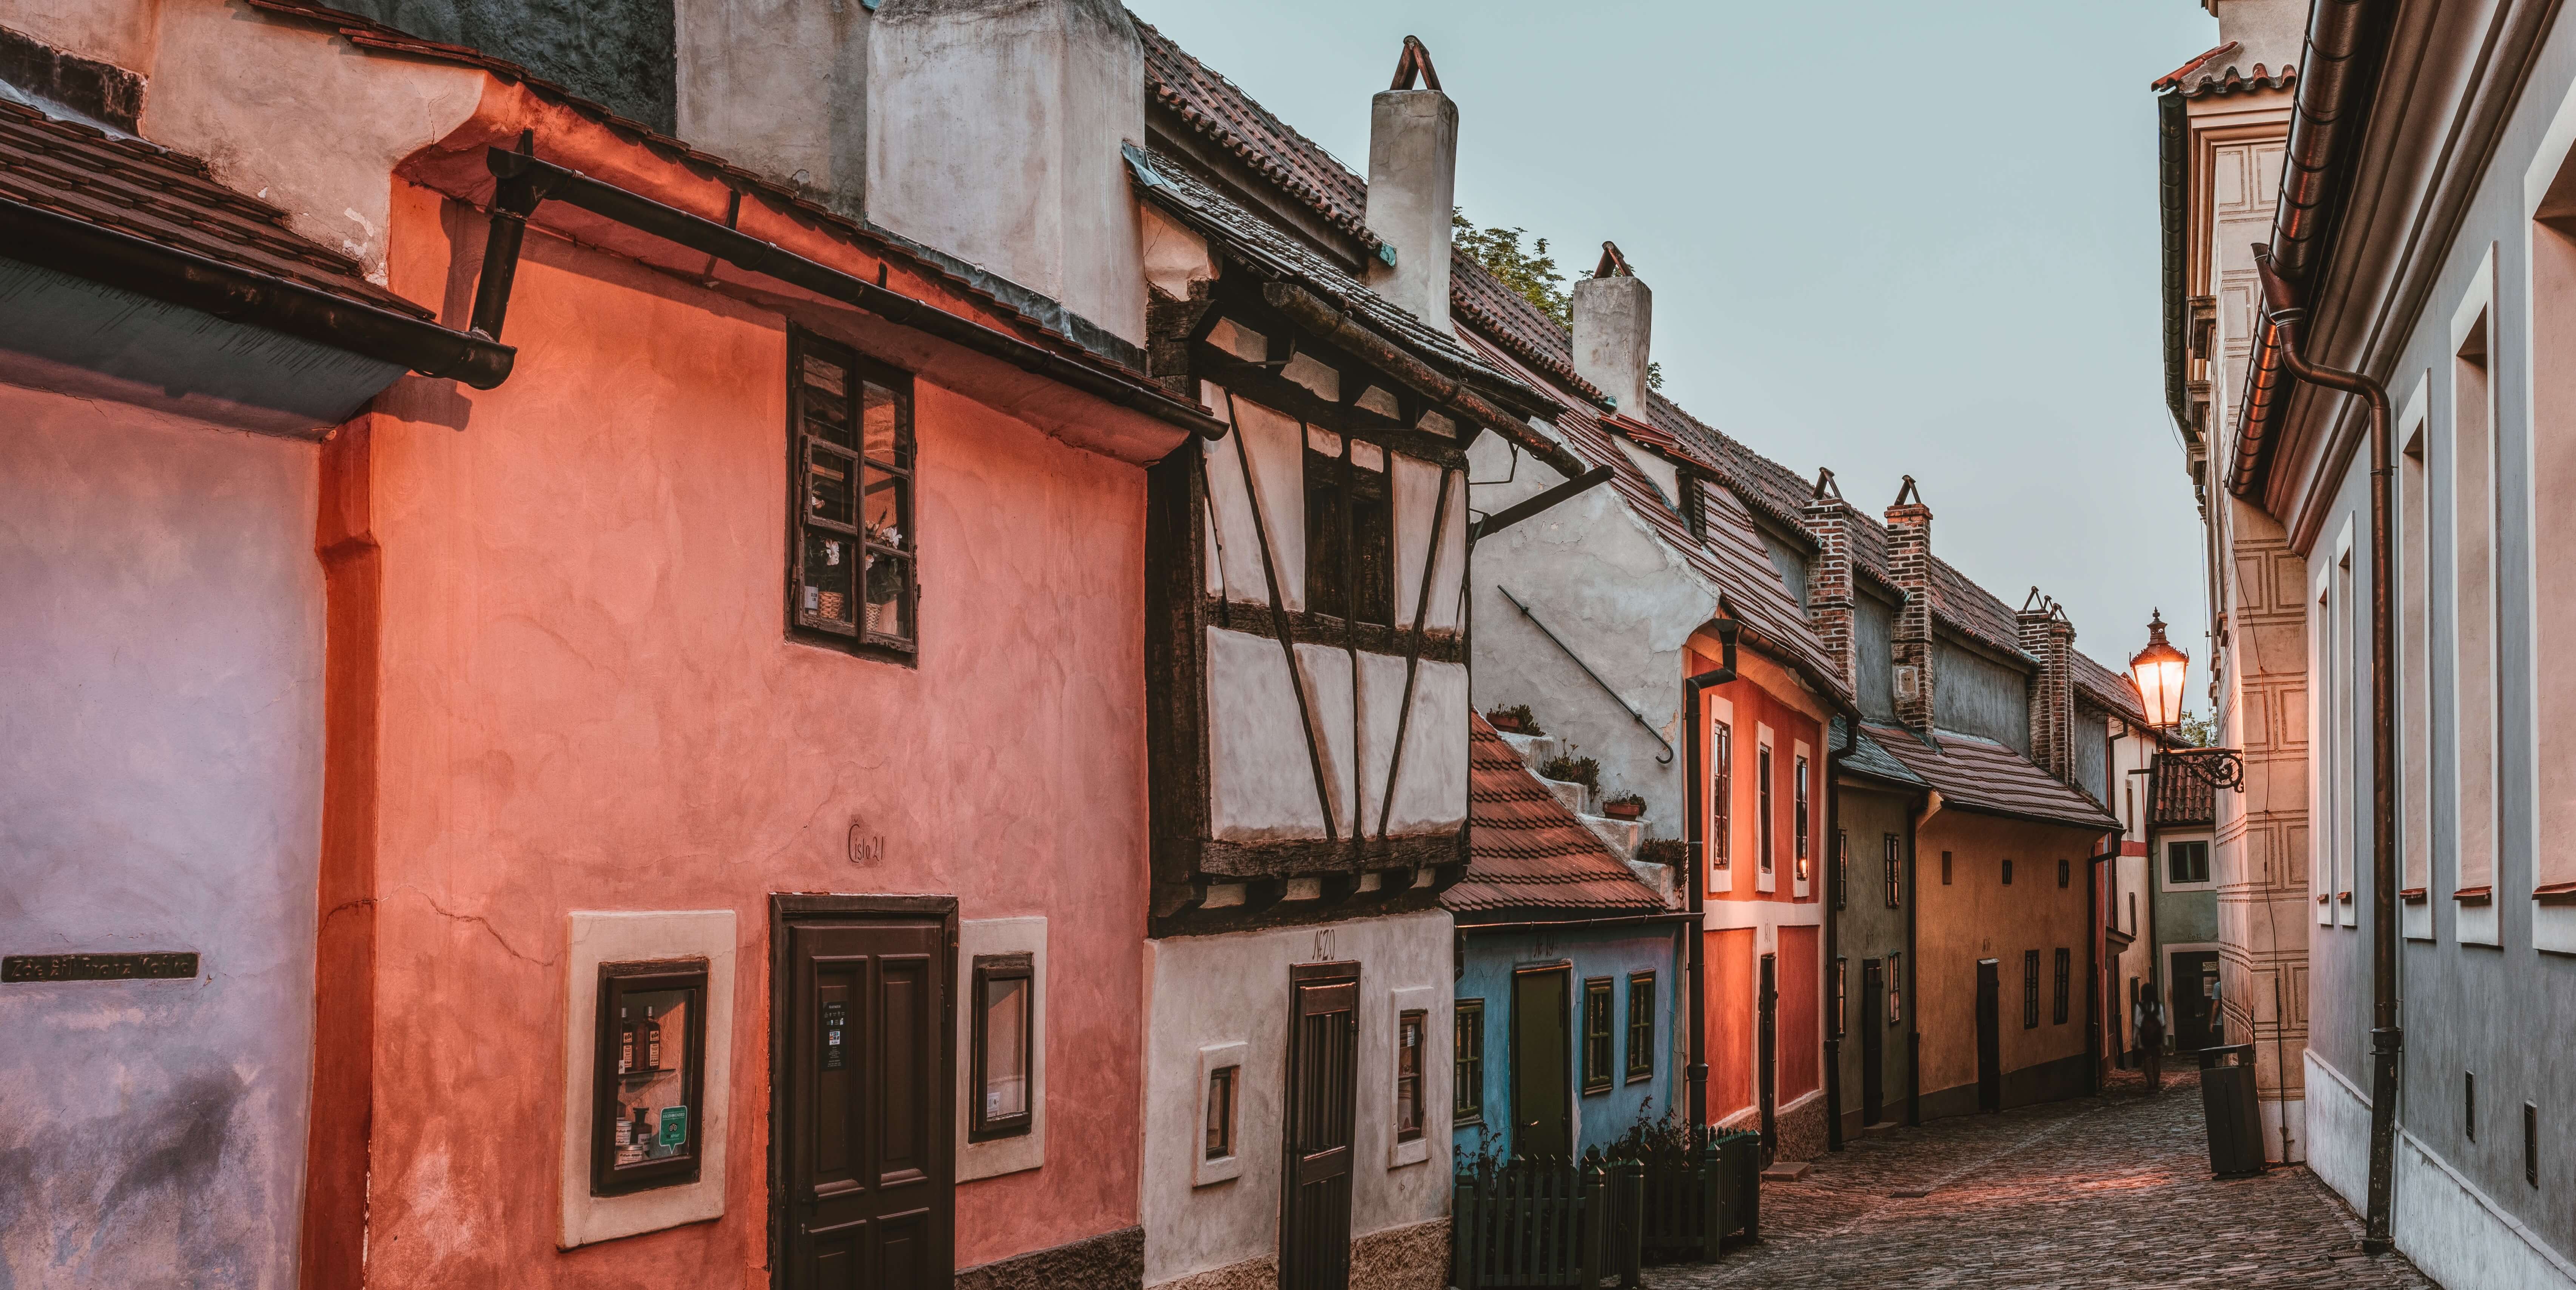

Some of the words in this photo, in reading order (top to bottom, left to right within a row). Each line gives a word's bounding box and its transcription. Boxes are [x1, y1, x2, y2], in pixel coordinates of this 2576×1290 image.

[873, 836, 883, 862] 21
[12, 959, 43, 978] Zde
[82, 957, 131, 976] Franz
[139, 955, 188, 976] Kafka
